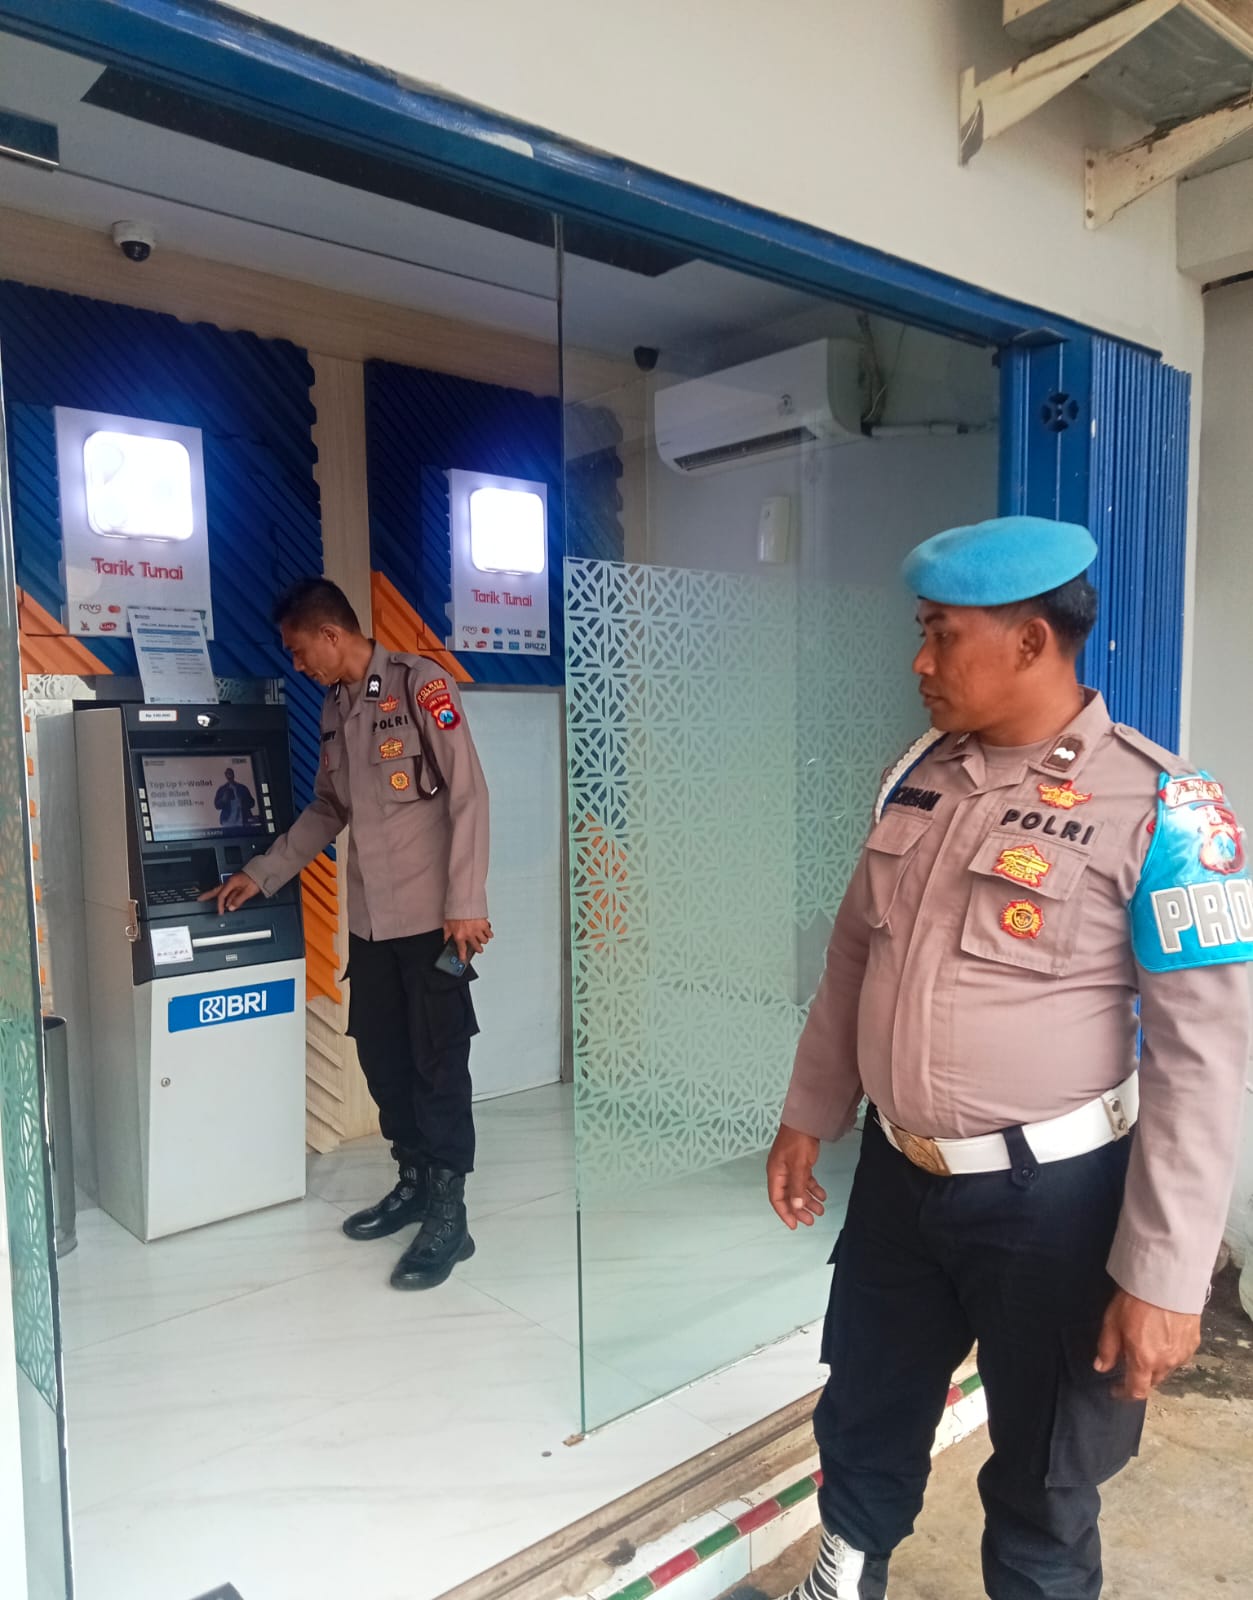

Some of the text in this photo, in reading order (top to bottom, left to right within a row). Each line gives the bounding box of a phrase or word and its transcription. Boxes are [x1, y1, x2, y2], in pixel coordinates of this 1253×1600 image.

[91, 557, 184, 581] Tarik Tunai
[471, 589, 532, 607] Tarik Tunai
[507, 628, 520, 636] VISA
[524, 641, 547, 650] BRIZZI
[372, 715, 409, 731] POLRI
[166, 781, 177, 789] Up
[1000, 808, 1095, 845] POLRI
[1150, 879, 1253, 954] PRO
[227, 990, 267, 1017] BRI
